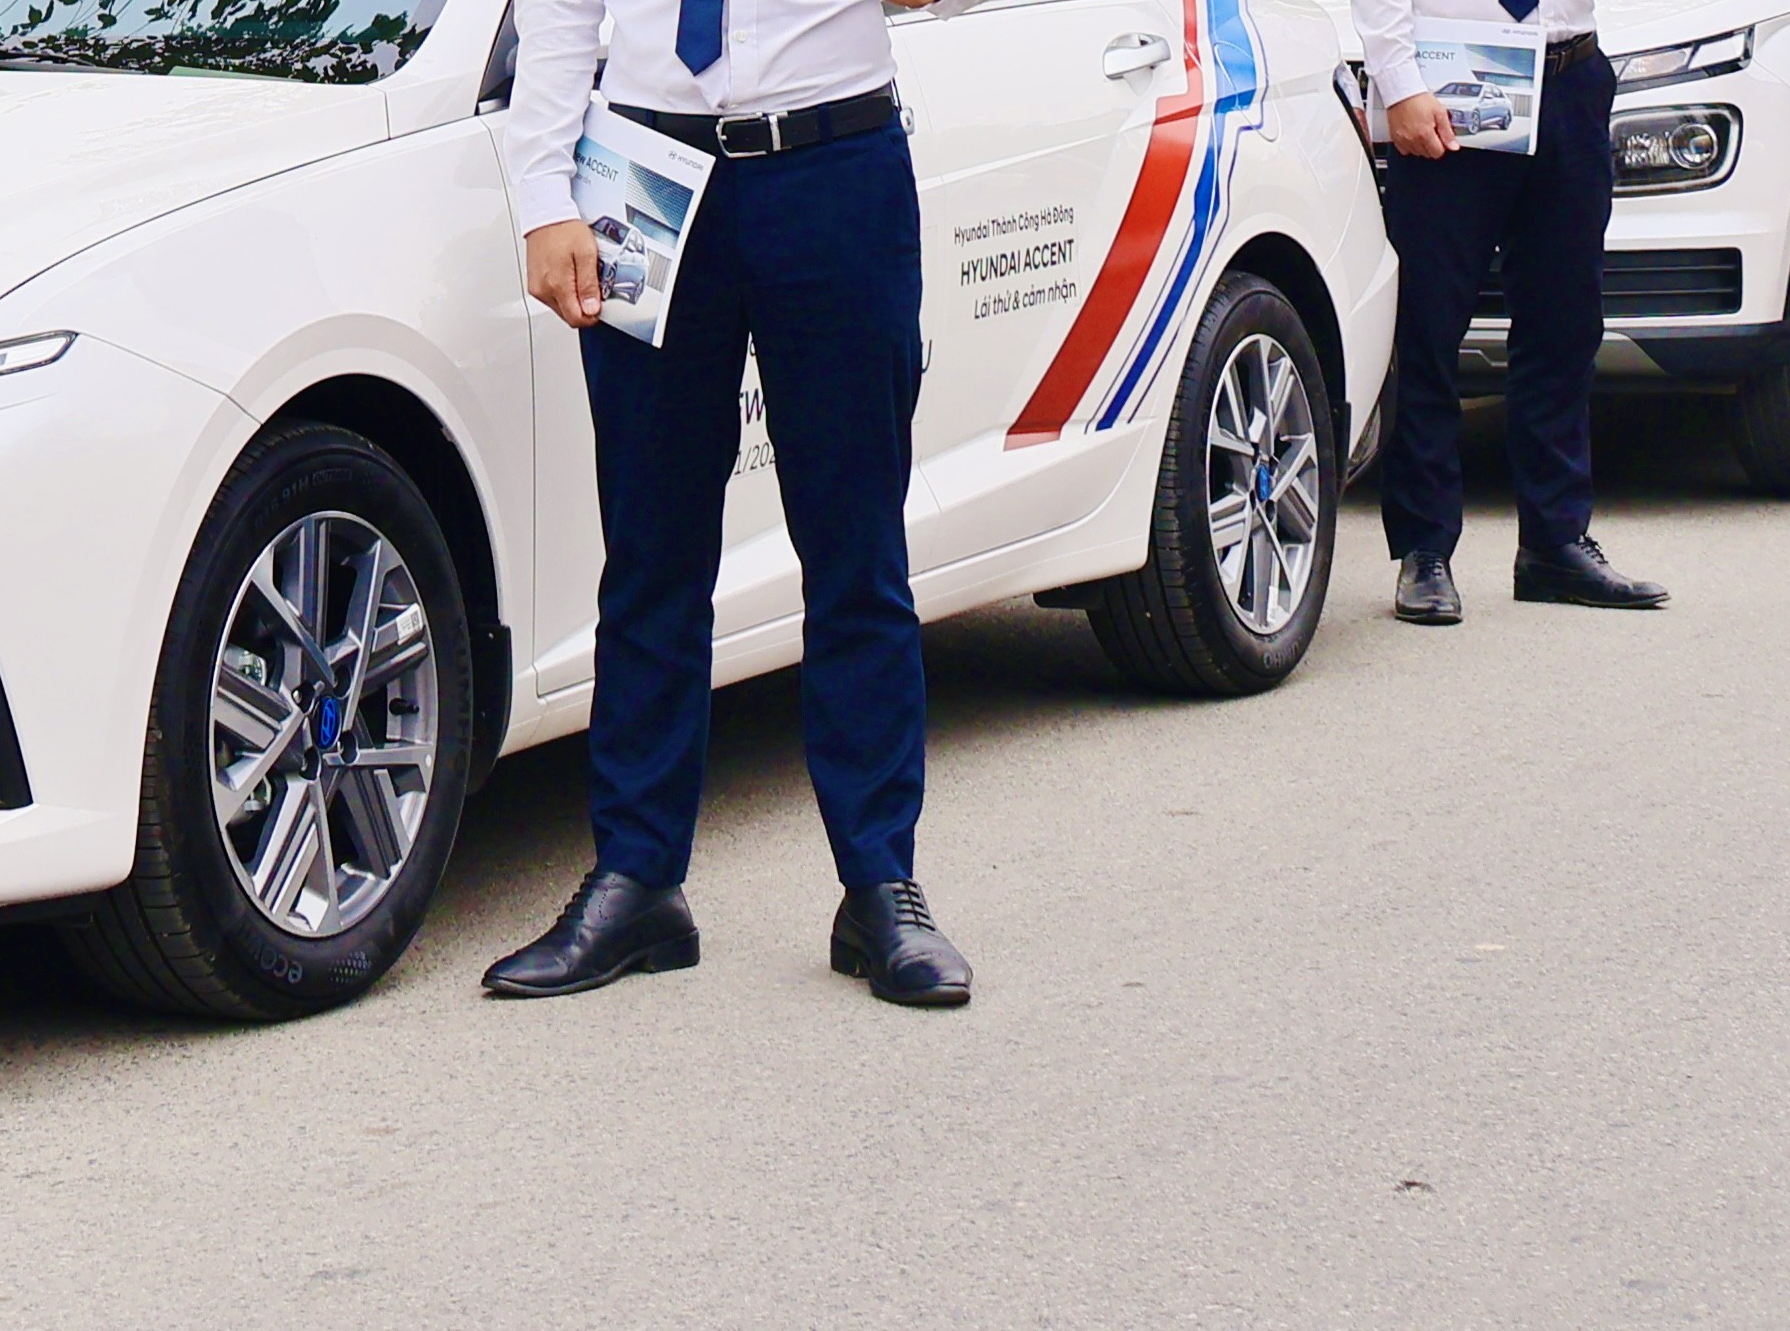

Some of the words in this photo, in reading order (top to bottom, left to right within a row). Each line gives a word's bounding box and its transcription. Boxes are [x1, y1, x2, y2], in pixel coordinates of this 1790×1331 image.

[1416, 50, 1456, 61] ACCENT
[586, 156, 619, 183] ACCENT
[954, 220, 989, 246] Hyundai
[991, 216, 1017, 237] Thành
[1018, 211, 1039, 231] Công
[1040, 207, 1051, 226] Hà
[961, 250, 1021, 286] HYUNDAI
[1023, 239, 1074, 272] ACCENT
[974, 294, 991, 319] Lái
[1012, 292, 1020, 310] &
[1022, 284, 1045, 308] cảm
[1047, 278, 1076, 304] nhận
